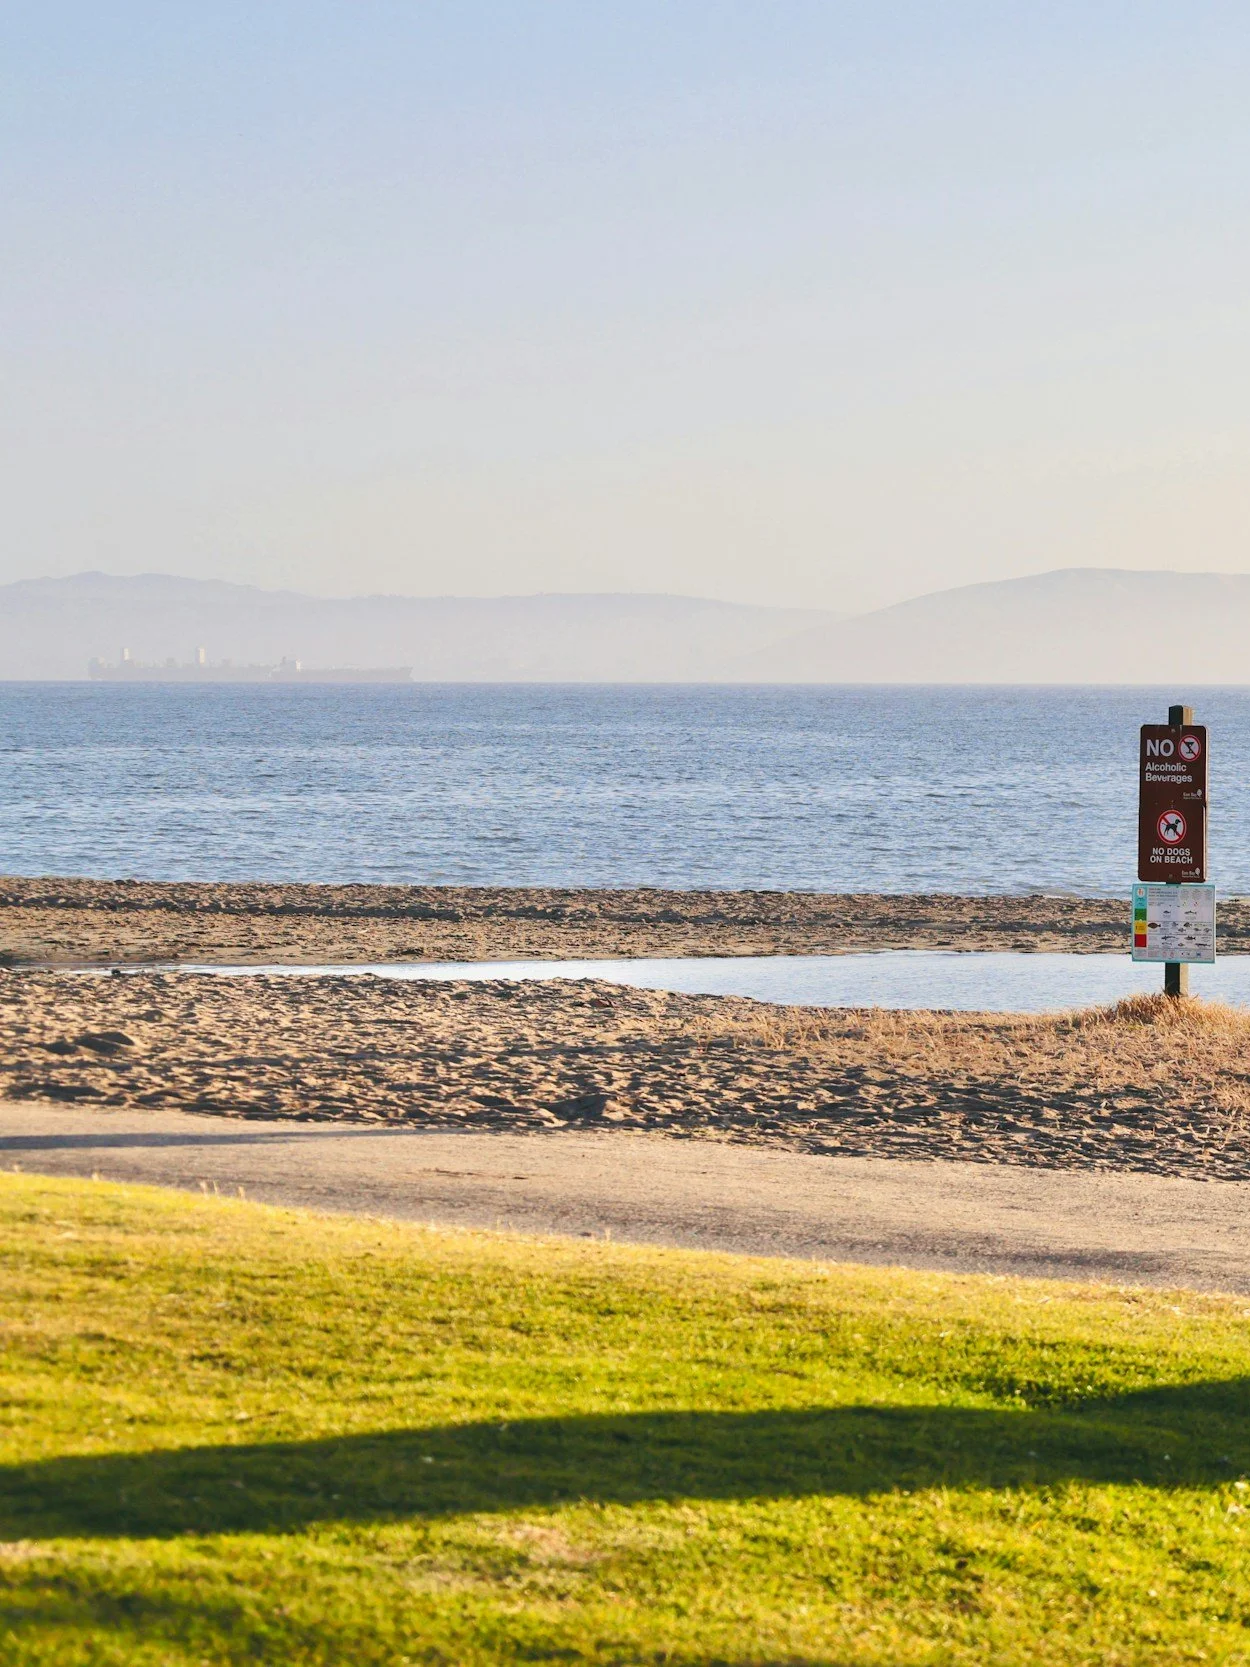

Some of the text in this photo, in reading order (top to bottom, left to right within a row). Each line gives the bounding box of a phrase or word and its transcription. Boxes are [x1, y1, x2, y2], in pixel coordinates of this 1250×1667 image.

[1146, 738, 1175, 757] NO
[1145, 762, 1187, 772] Alcoholic
[1145, 772, 1193, 784] Beverages
[1152, 847, 1191, 856] NO DOGS
[1149, 855, 1193, 864] ON BEACH
